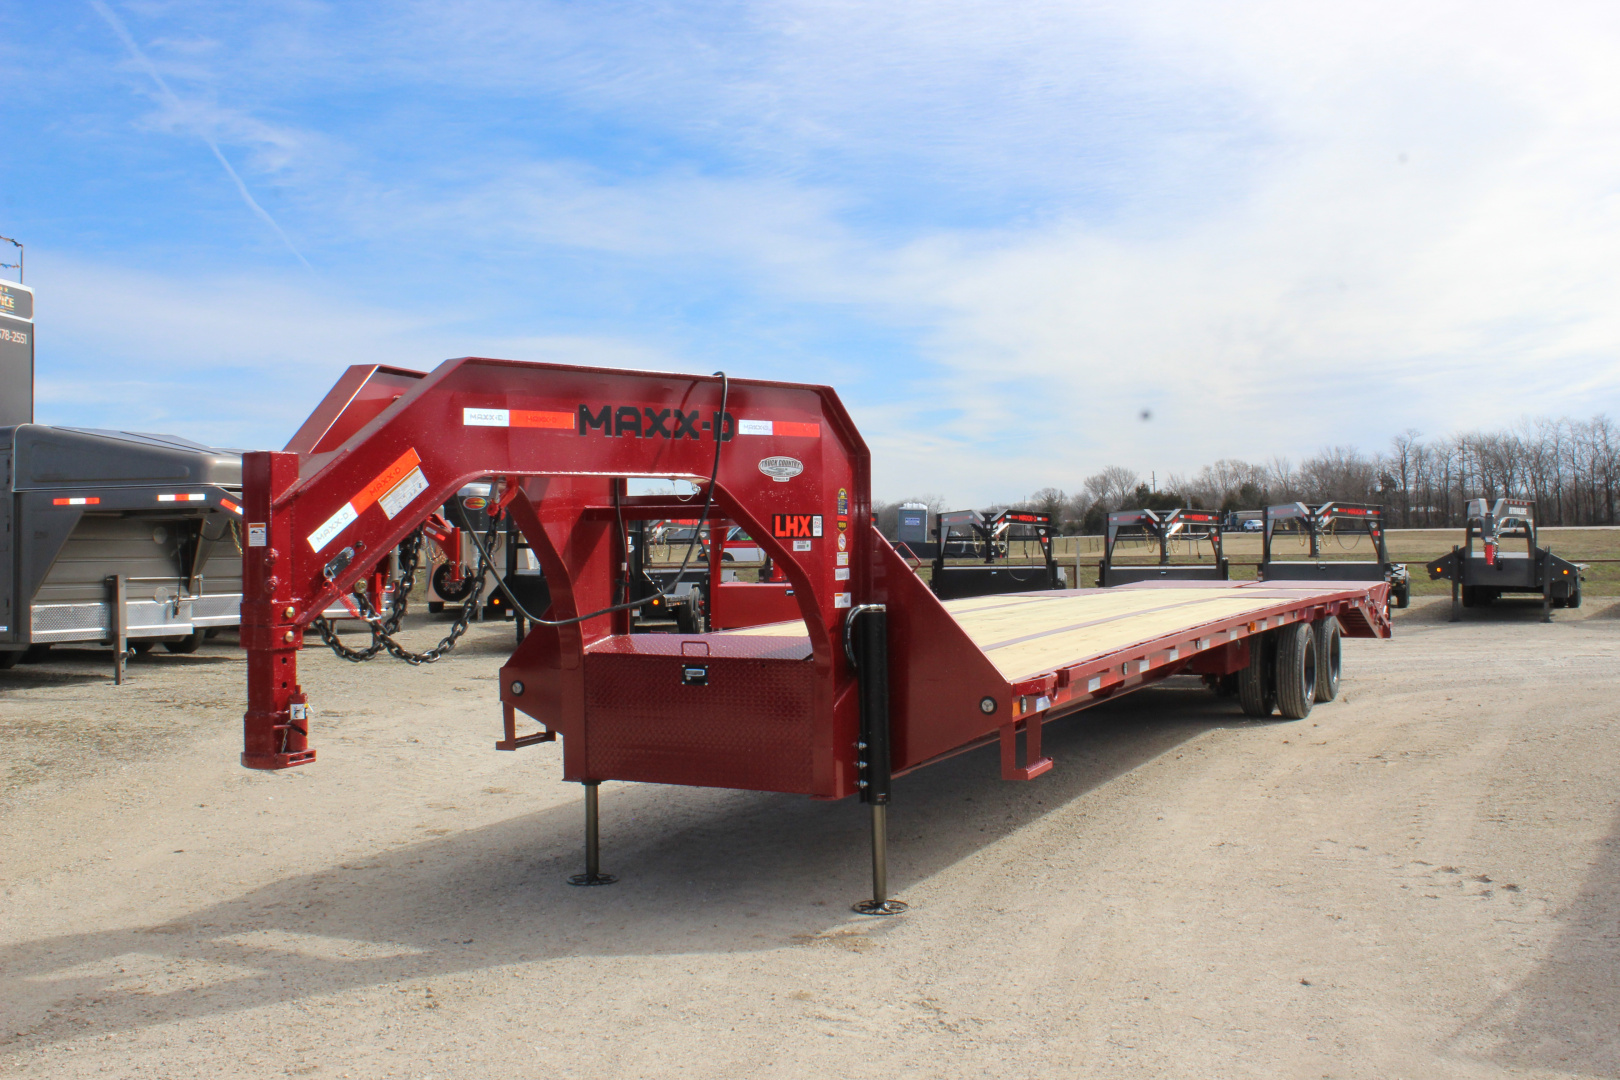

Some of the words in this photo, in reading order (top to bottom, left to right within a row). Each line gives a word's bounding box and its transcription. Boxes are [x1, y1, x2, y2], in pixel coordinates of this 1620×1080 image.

[0, 328, 27, 345] 78-2551
[578, 403, 735, 442] MAXX-D
[368, 466, 401, 497] MAXX-D
[315, 511, 350, 543] MAXX-D
[774, 515, 811, 537] LHX
